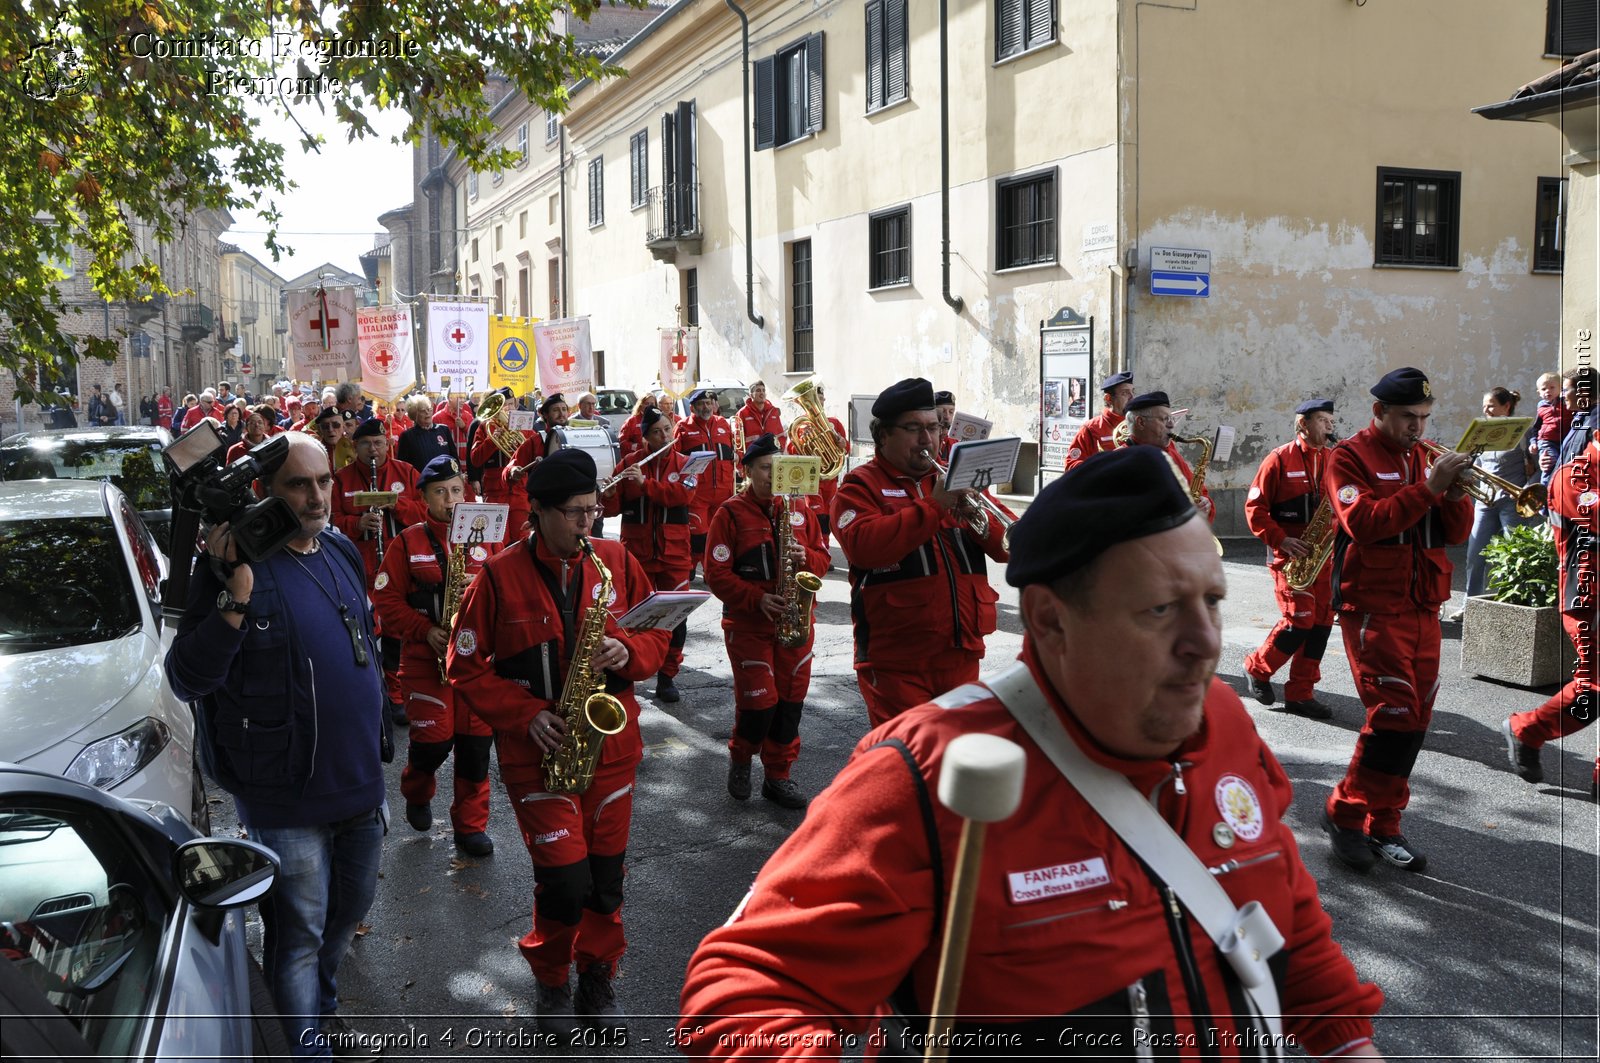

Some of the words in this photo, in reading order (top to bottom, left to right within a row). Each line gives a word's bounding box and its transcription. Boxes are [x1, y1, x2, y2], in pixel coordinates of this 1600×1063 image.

[1162, 249, 1172, 257] Don
[1172, 250, 1193, 260] Giuseppe
[1193, 252, 1208, 260] Pipino
[358, 315, 379, 325] ROCE
[381, 313, 408, 323] ROSSA
[363, 322, 399, 333] ITALIANA
[543, 328, 562, 337] CROCE
[331, 338, 356, 346] LOCALE
[549, 333, 575, 342] ITALIANA
[307, 352, 348, 361] SANTENA
[1023, 862, 1090, 886] FANFARA
[1014, 888, 1042, 900] Croce
[1043, 882, 1072, 895] Rossa
[1074, 875, 1108, 888] Italiana
